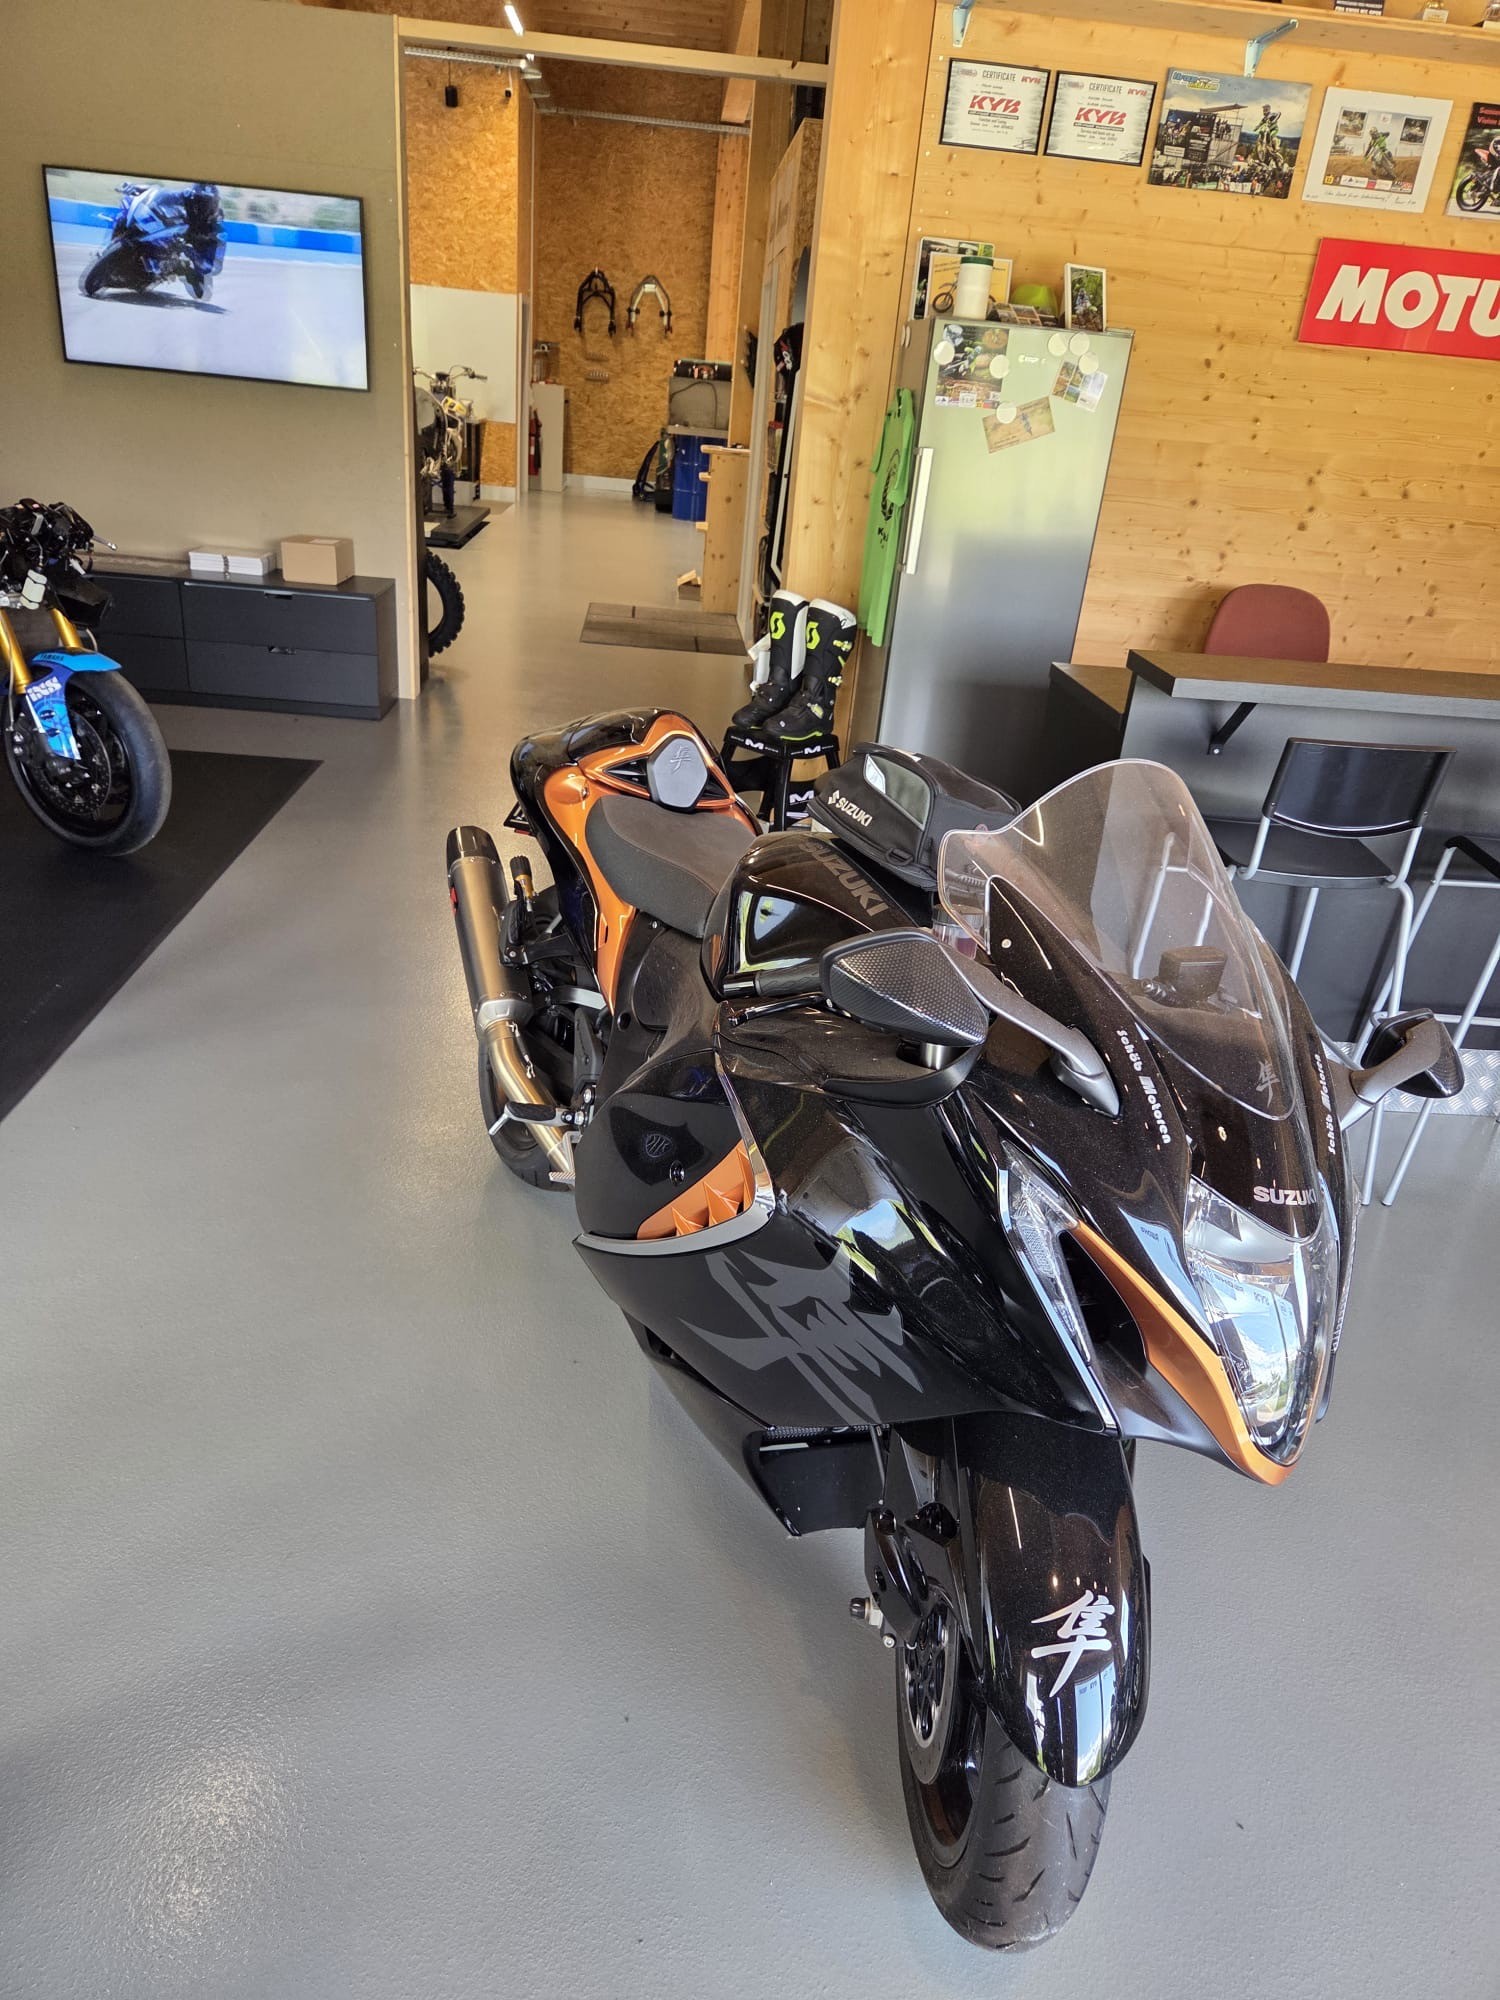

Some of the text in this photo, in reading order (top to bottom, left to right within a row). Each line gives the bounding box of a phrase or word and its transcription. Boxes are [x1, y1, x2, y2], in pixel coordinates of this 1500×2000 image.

[982, 69, 1016, 82] CERTIFICATE
[1089, 82, 1123, 95] CERTIFICATE
[969, 94, 1021, 114] KYB
[1075, 107, 1127, 126] KYB
[836, 797, 873, 827] SUZUKI
[798, 840, 889, 917] SUZUKI
[1138, 1075, 1171, 1144] Motoren
[1253, 1185, 1317, 1206] SUZUKI
[1031, 1589, 1115, 1697] 隼
